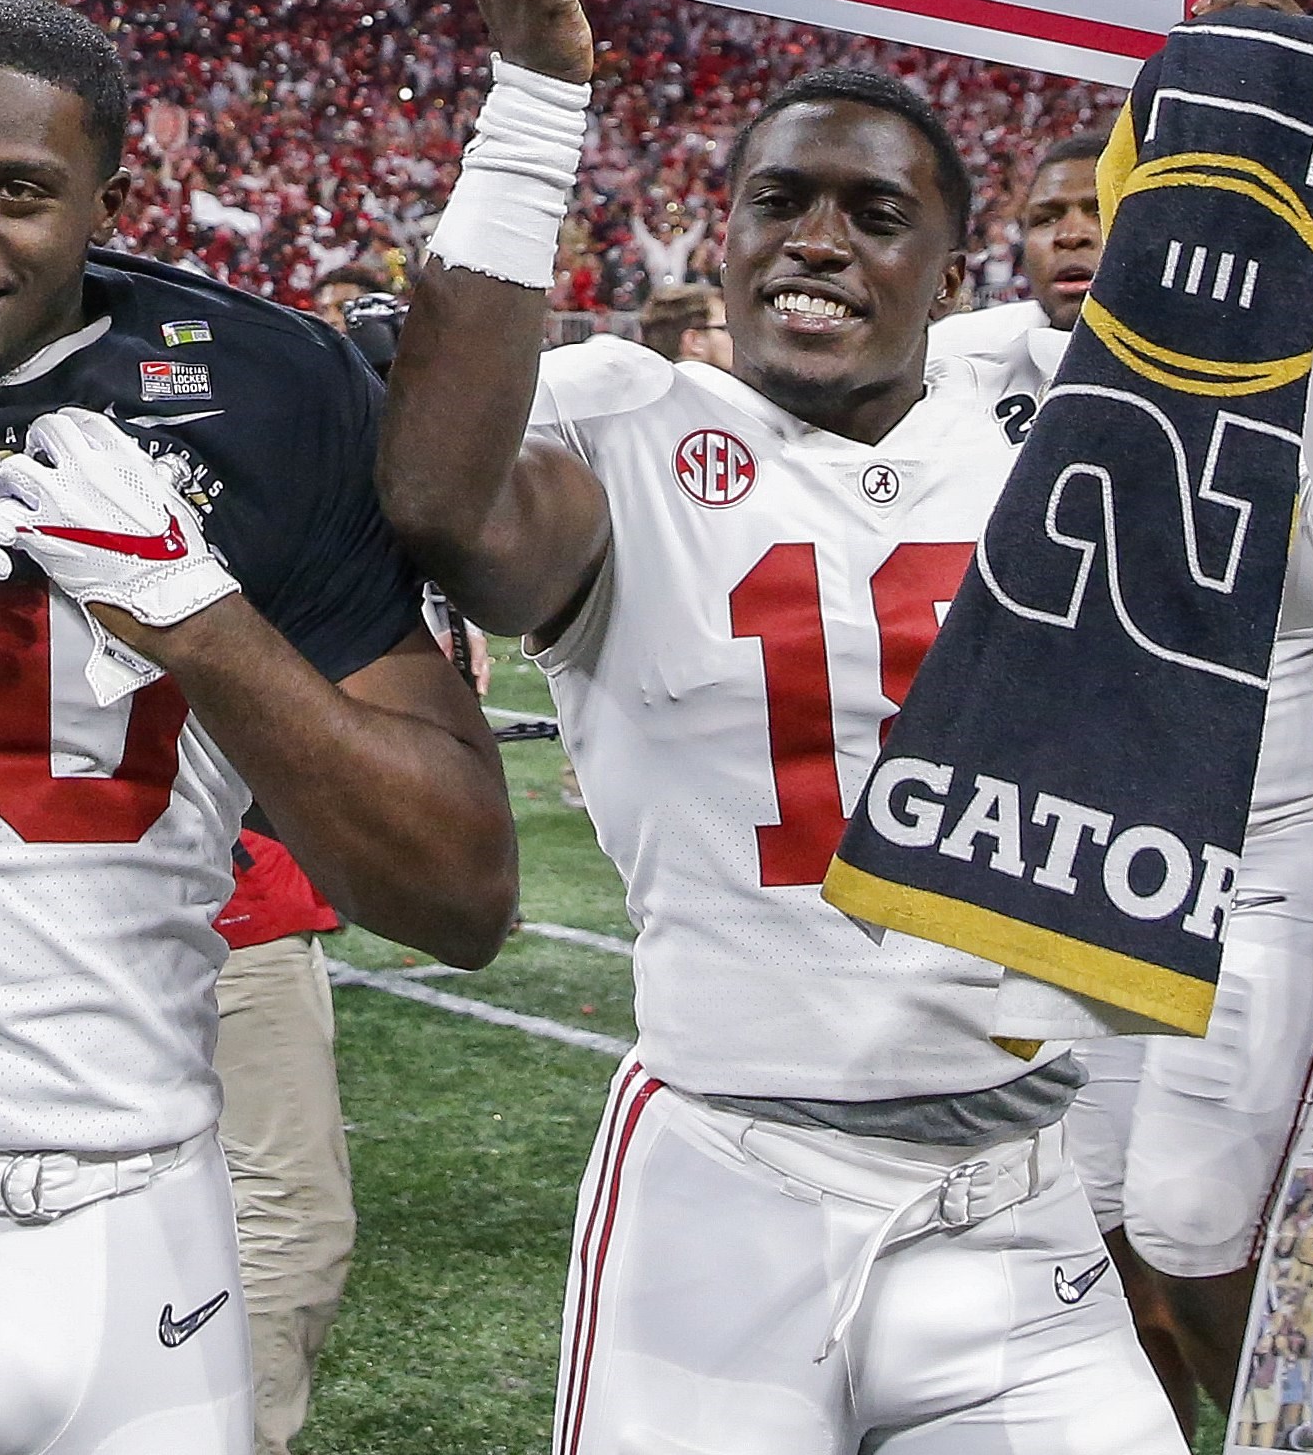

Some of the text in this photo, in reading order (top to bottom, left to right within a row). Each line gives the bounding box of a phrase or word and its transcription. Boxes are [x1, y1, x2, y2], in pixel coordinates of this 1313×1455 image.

[171, 365, 208, 375] OFFICIAL
[172, 374, 208, 384] LOCKER
[173, 383, 209, 394] ROOM
[680, 430, 750, 501] SEC
[868, 756, 1241, 944] GATOR
